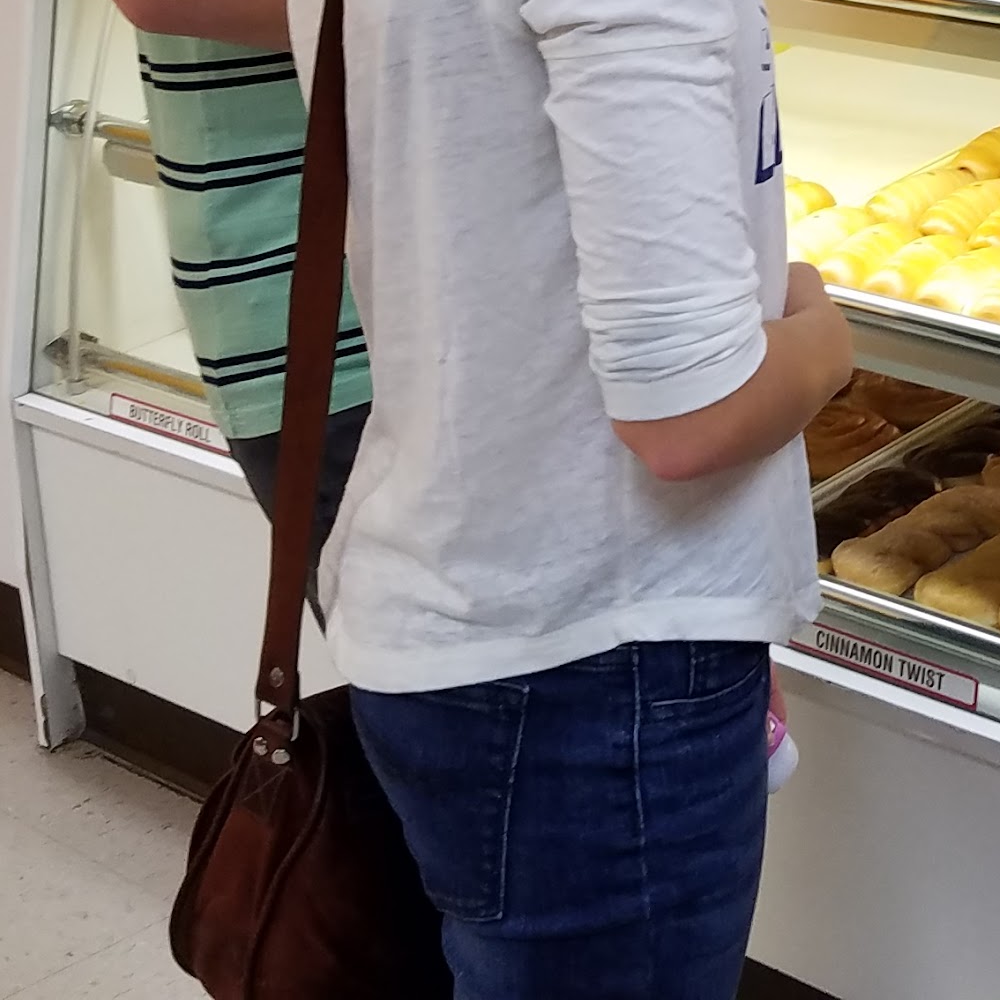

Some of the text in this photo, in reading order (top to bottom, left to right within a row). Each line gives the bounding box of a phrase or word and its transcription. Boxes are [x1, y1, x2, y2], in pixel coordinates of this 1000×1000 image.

[128, 404, 211, 443] BUTTERFLY ROLL
[815, 630, 946, 691] CINNAMON TWIST
